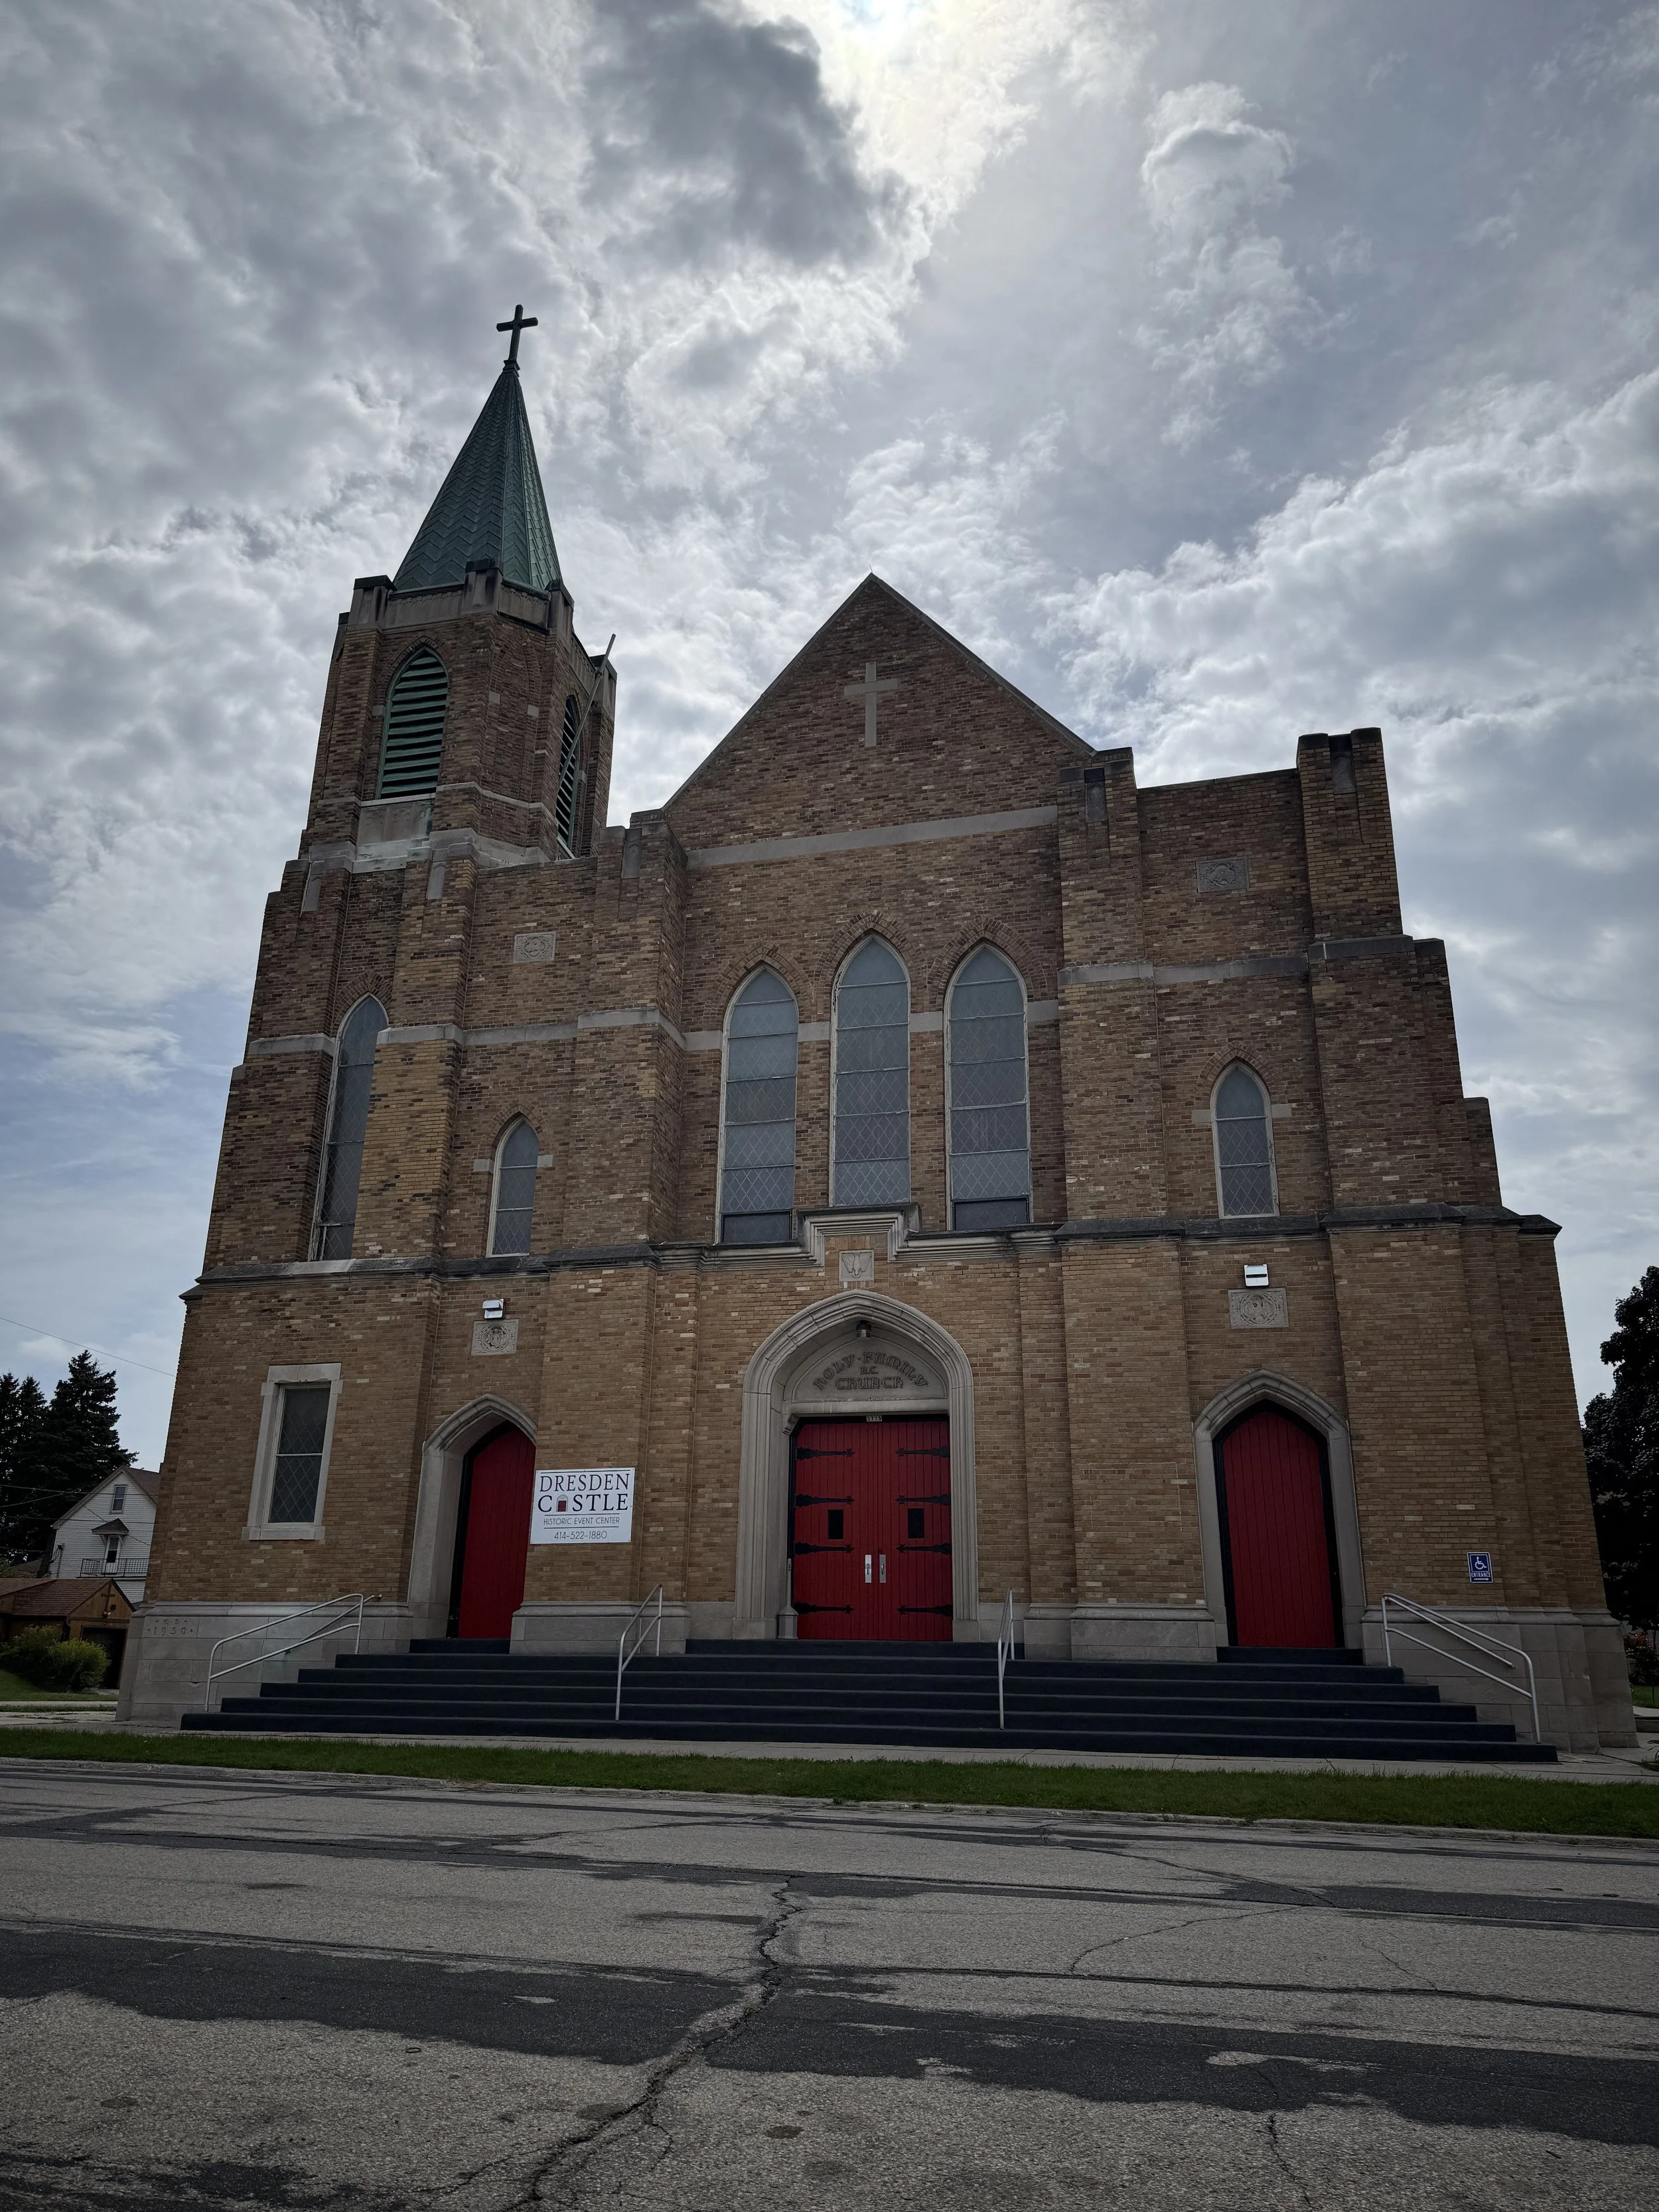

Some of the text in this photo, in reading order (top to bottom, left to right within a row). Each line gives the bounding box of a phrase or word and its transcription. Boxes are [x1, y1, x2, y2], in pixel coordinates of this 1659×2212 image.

[813, 1351, 929, 1390] HOLY FAMILY
[835, 1376, 903, 1390] CHURCH
[540, 1473, 630, 1492] DRESDEN
[538, 1493, 628, 1512] CSTLE
[554, 1530, 607, 1540] 414-522-1880
[153, 1627, 186, 1636] 1930
